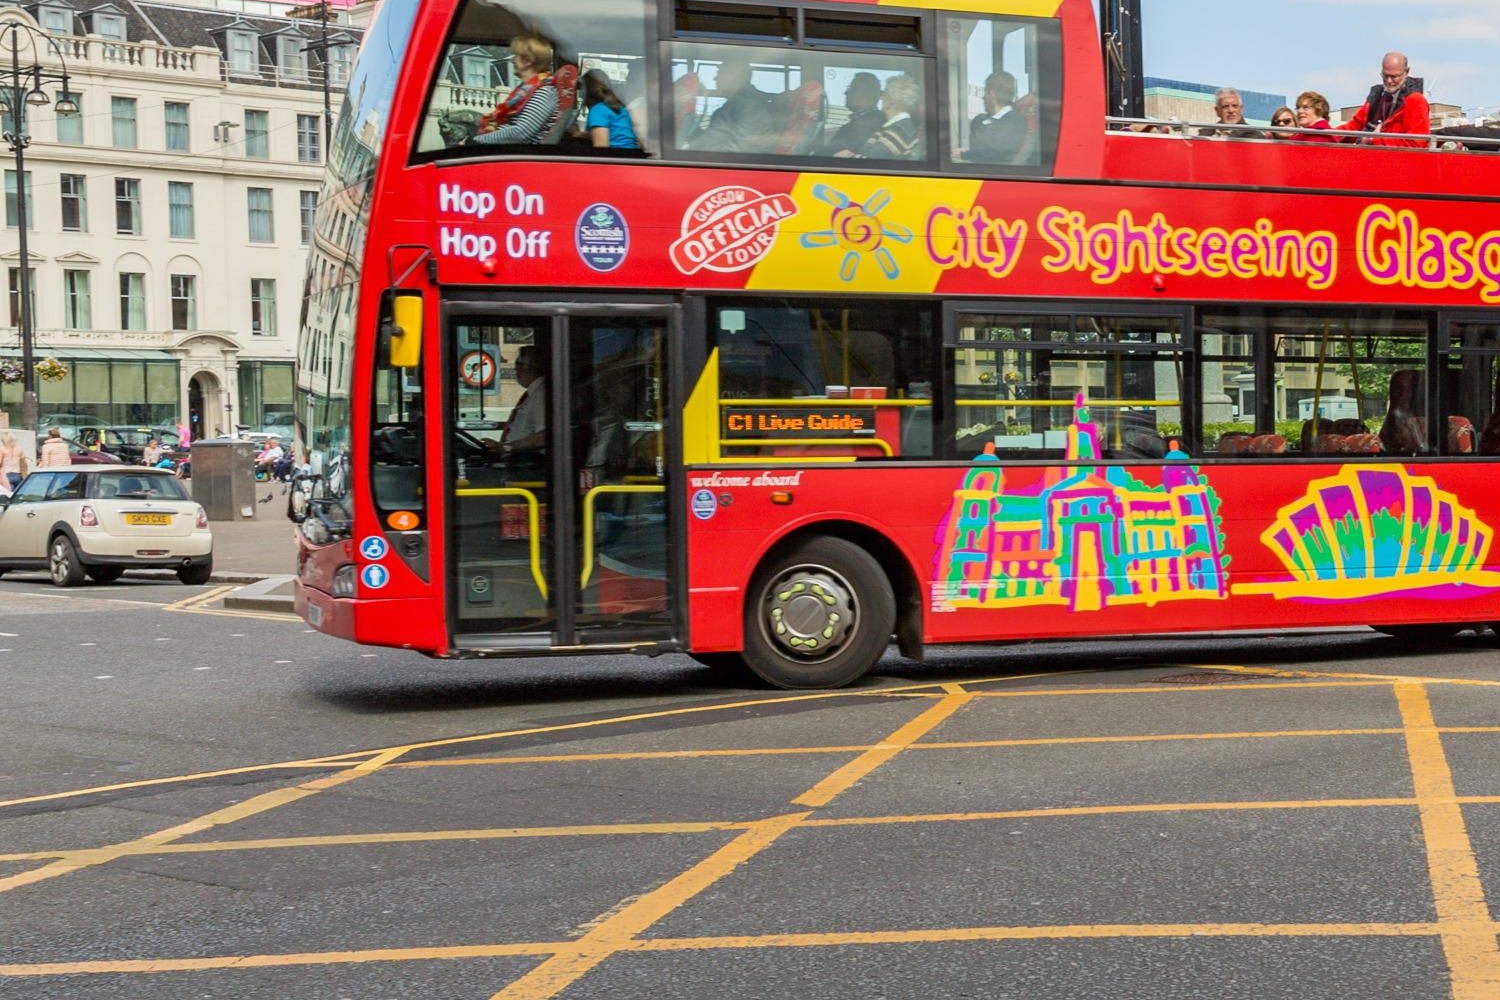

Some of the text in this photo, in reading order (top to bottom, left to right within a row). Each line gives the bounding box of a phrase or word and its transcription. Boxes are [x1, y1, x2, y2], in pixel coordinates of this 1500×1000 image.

[439, 183, 544, 219] Hop On
[693, 191, 745, 222] GLASGOW
[440, 226, 551, 261] Hop Off
[684, 199, 792, 262] OFFICIAL
[724, 233, 773, 264] TOUR
[923, 205, 1027, 278] City
[1038, 206, 1336, 290] Sightseeing
[728, 414, 864, 430] C1 Live Guide
[690, 471, 804, 487] welcome aboard
[397, 514, 409, 527] 4
